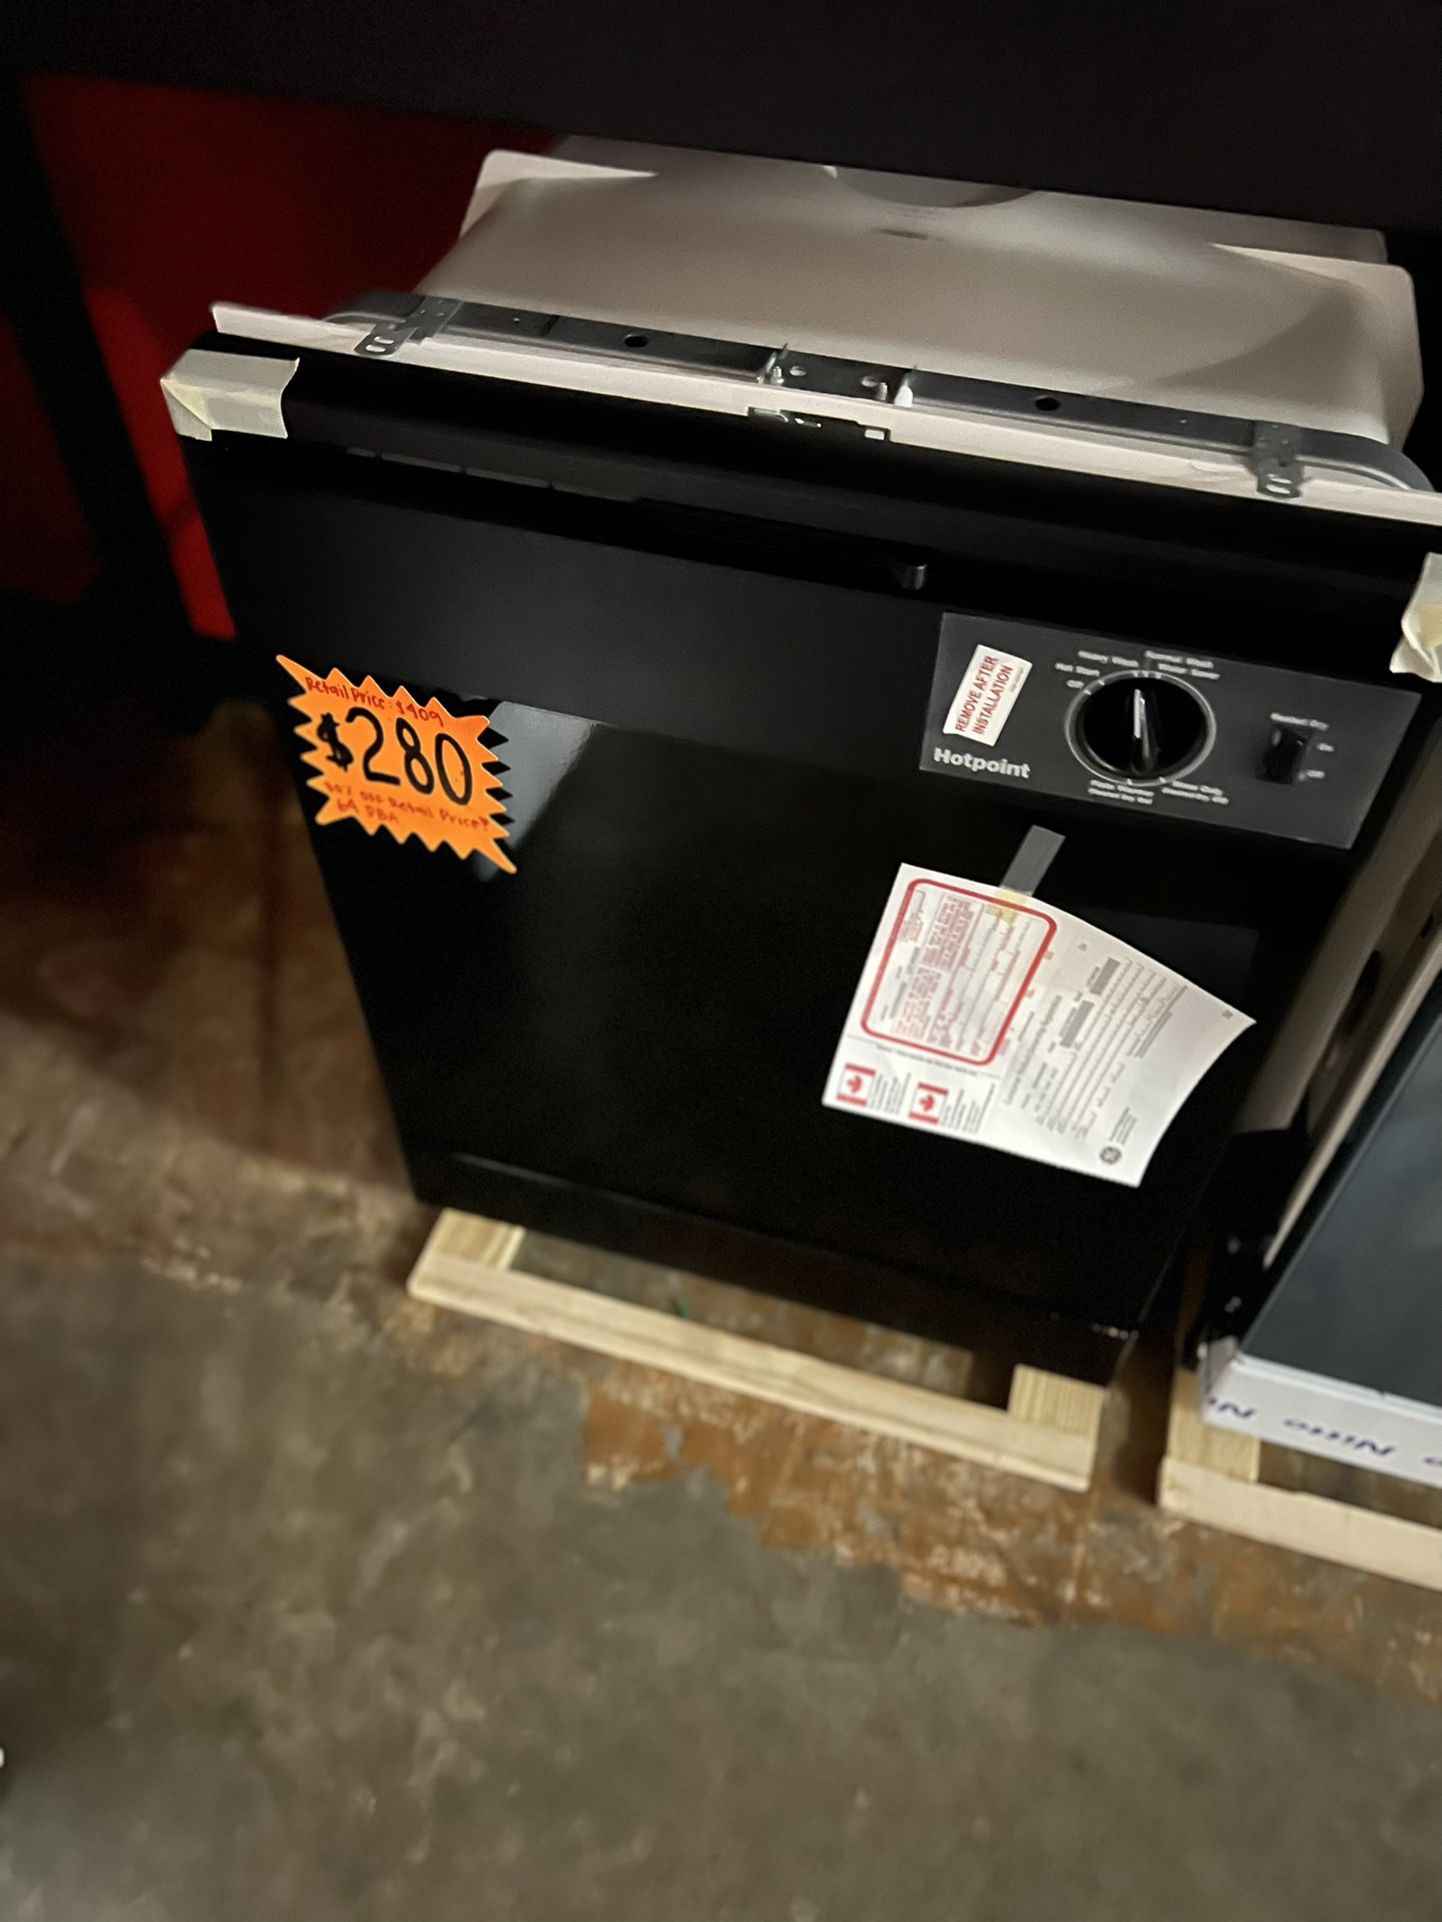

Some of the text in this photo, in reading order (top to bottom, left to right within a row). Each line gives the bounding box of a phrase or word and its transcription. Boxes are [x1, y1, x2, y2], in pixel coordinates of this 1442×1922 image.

[955, 655, 998, 732] REMOVE AFTER
[972, 664, 1013, 735] INSTALLATION
[316, 706, 473, 806] $280
[933, 746, 1031, 779] Hotpoint
[1282, 1417, 1396, 1457] Nitto
